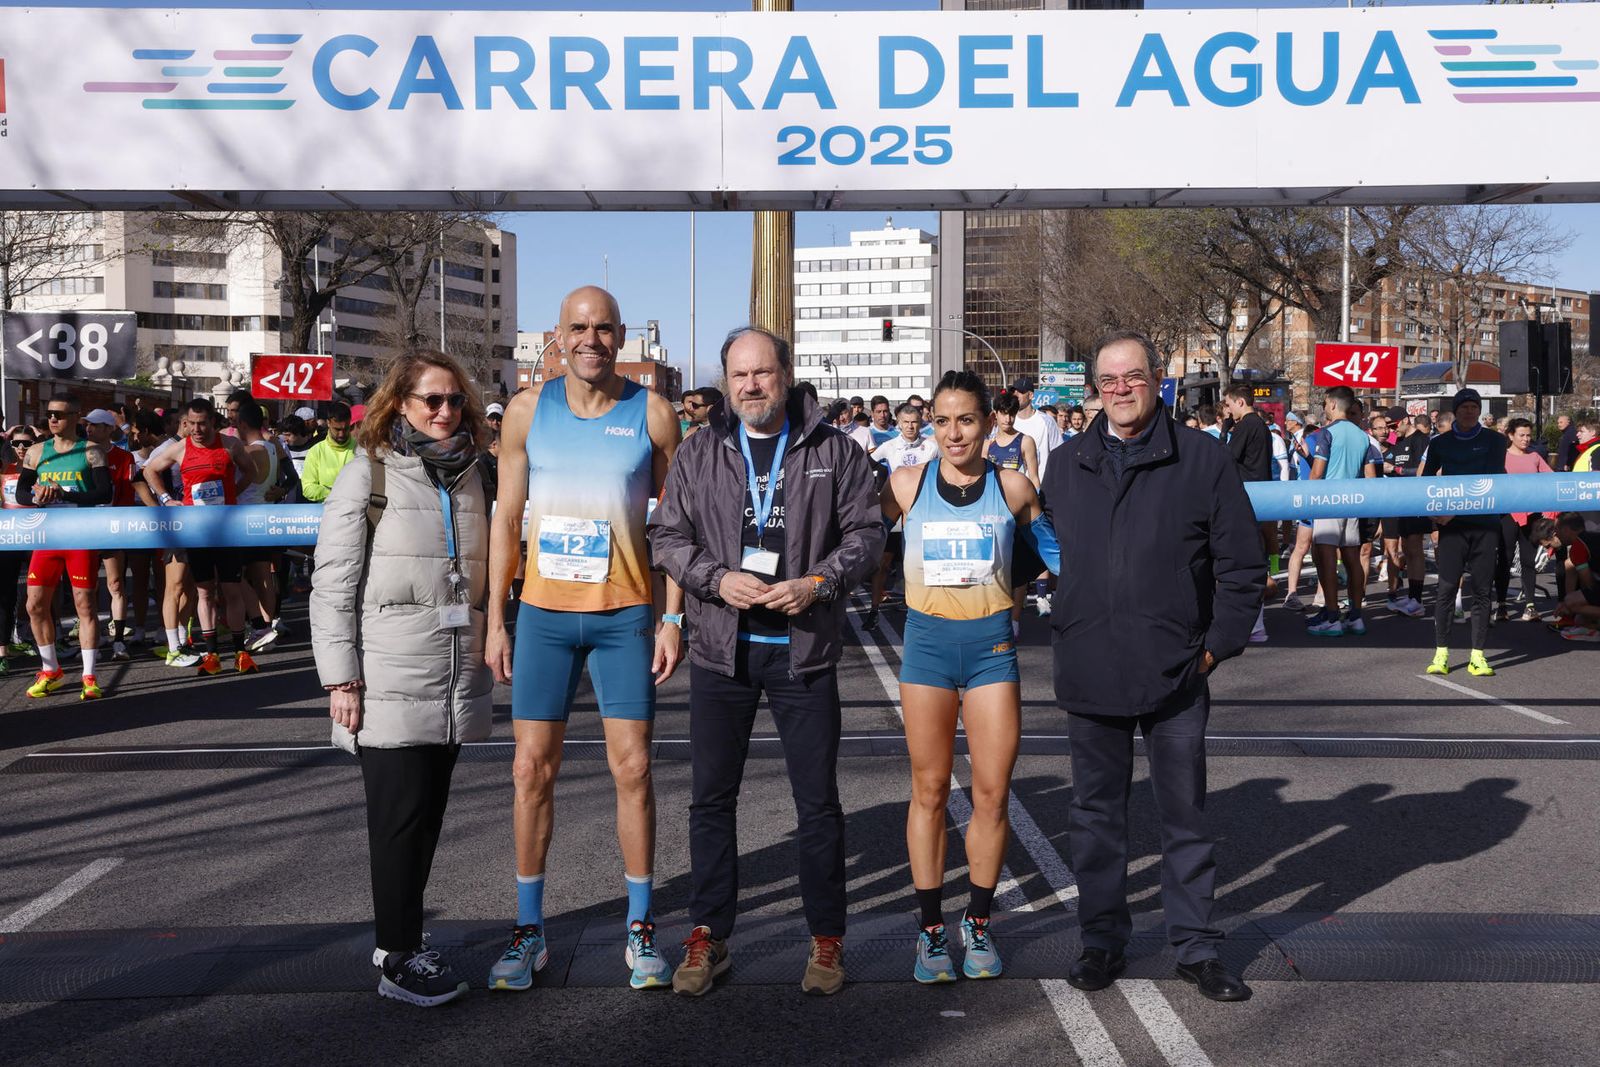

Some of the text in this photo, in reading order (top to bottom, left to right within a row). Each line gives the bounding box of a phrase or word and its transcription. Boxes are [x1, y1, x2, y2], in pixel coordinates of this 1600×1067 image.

[313, 30, 1421, 111] CARRERA DEL AGUA
[777, 125, 952, 165] 2025
[605, 426, 635, 437] HOKA
[1427, 483, 1464, 498] Canal
[1310, 494, 1365, 505] MADRID
[1426, 500, 1443, 512] de
[1446, 498, 1484, 511] Isabel
[128, 521, 183, 532] MADRID
[269, 526, 318, 535] de Madri
[561, 536, 585, 556] 12
[948, 540, 967, 559] 11
